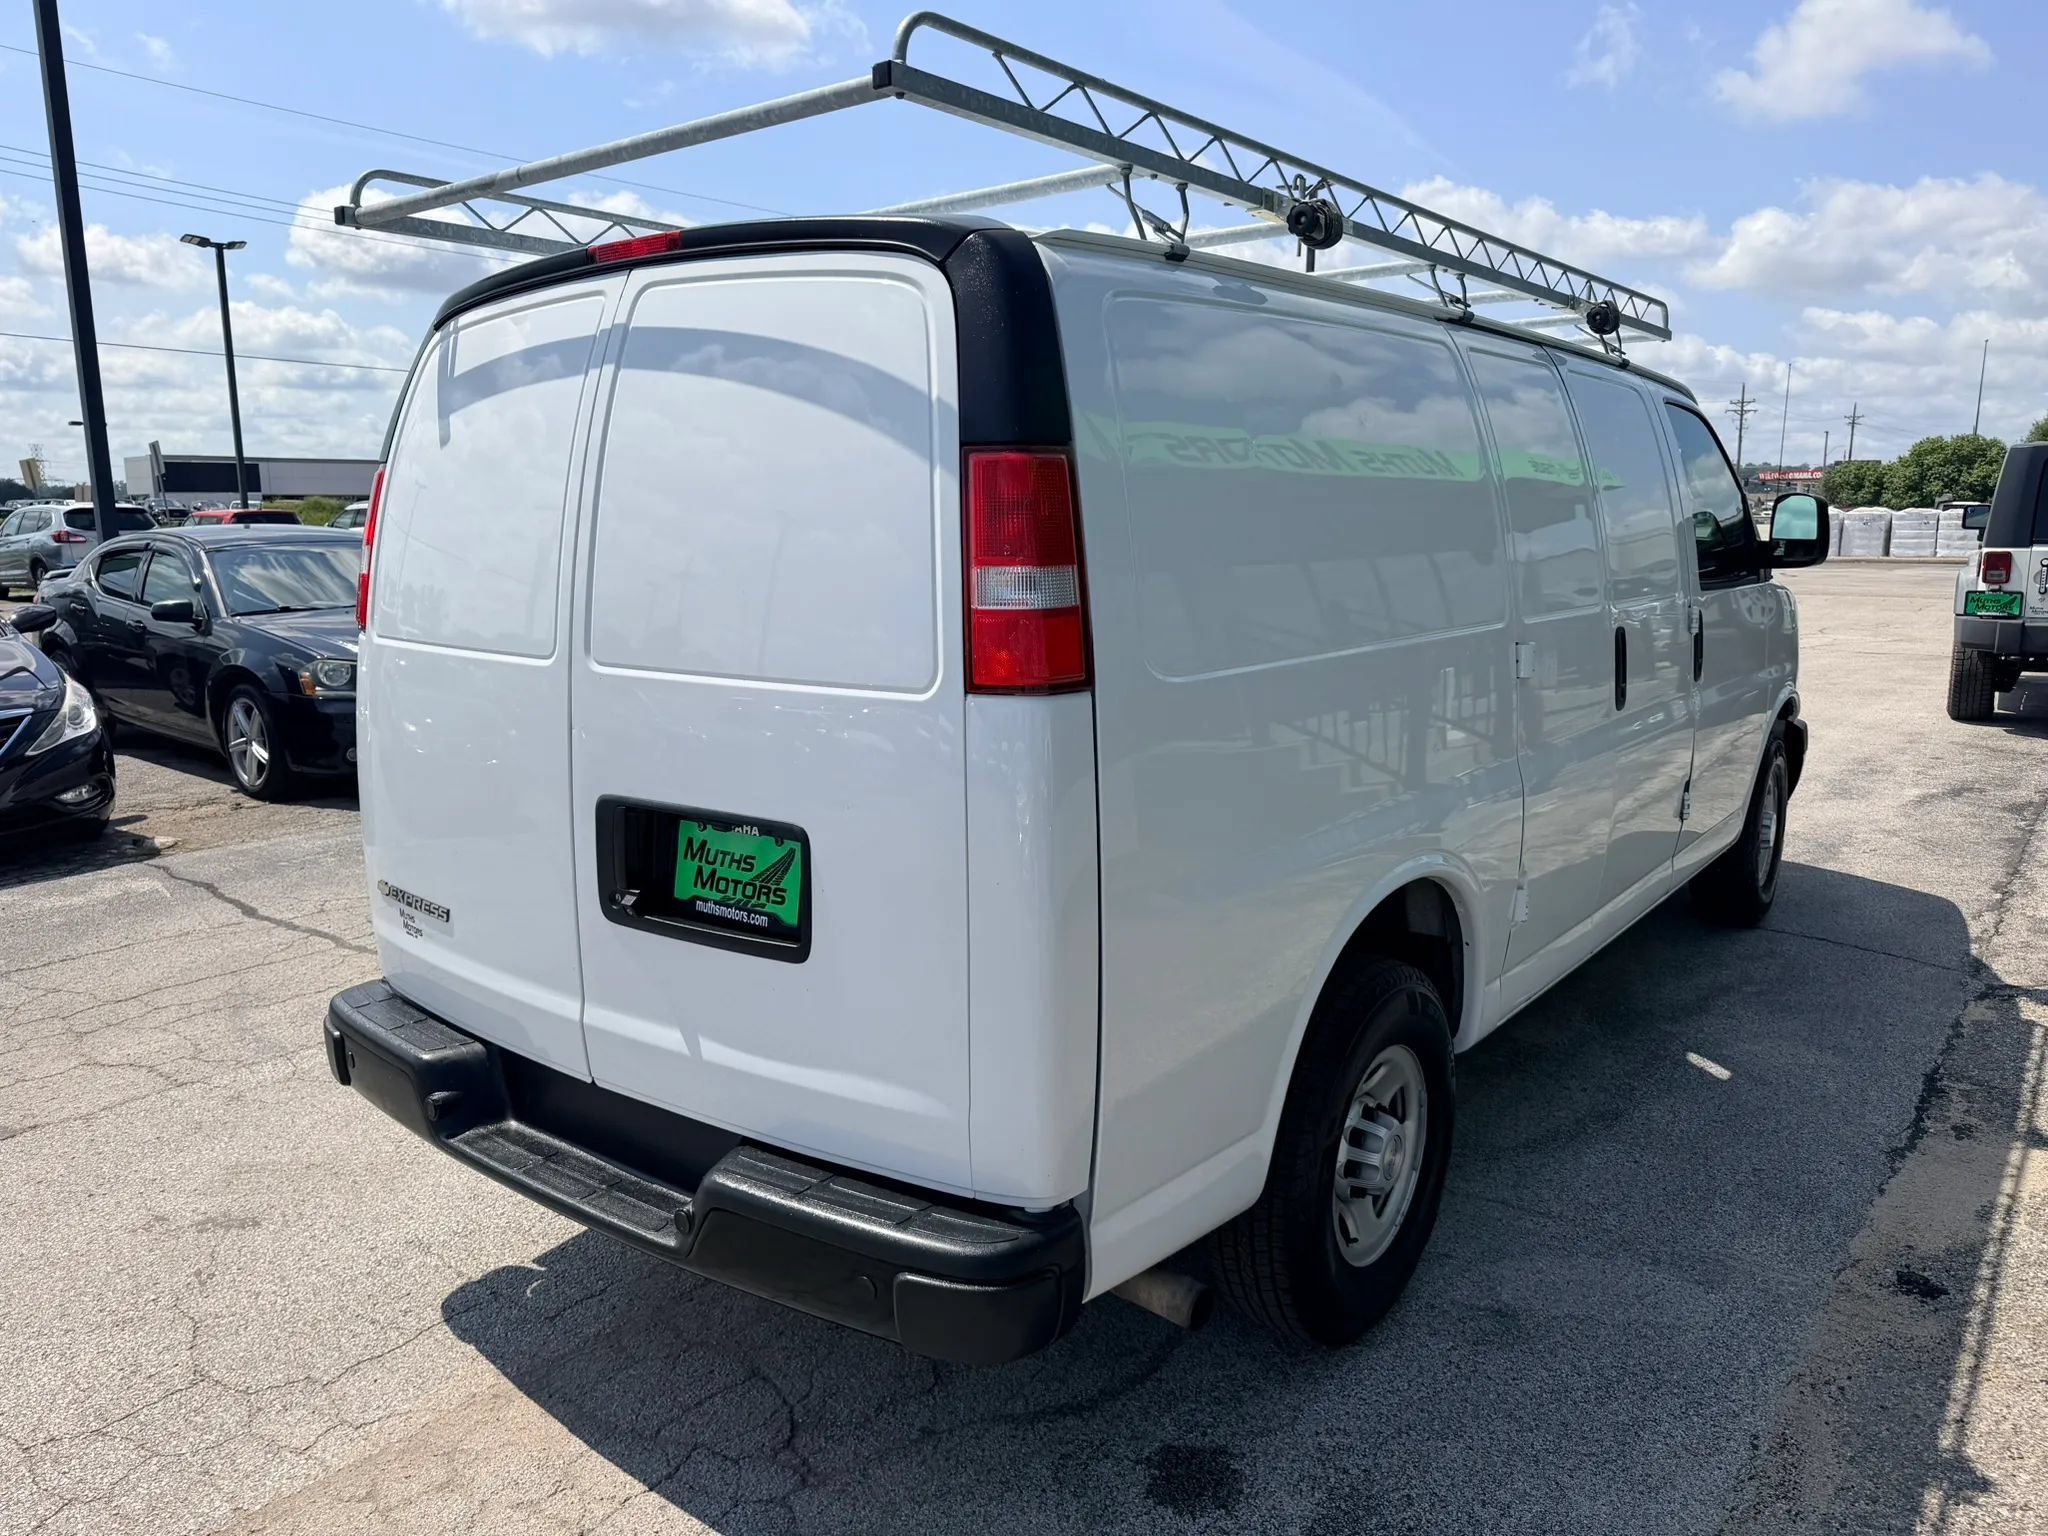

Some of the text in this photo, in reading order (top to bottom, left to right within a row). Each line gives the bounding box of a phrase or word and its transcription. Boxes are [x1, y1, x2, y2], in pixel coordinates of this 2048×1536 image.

[683, 836, 757, 873] MUTHS
[389, 884, 450, 923] EXPRESS
[693, 866, 787, 906] MOTORS
[695, 900, 769, 928] muthsmotors.com
